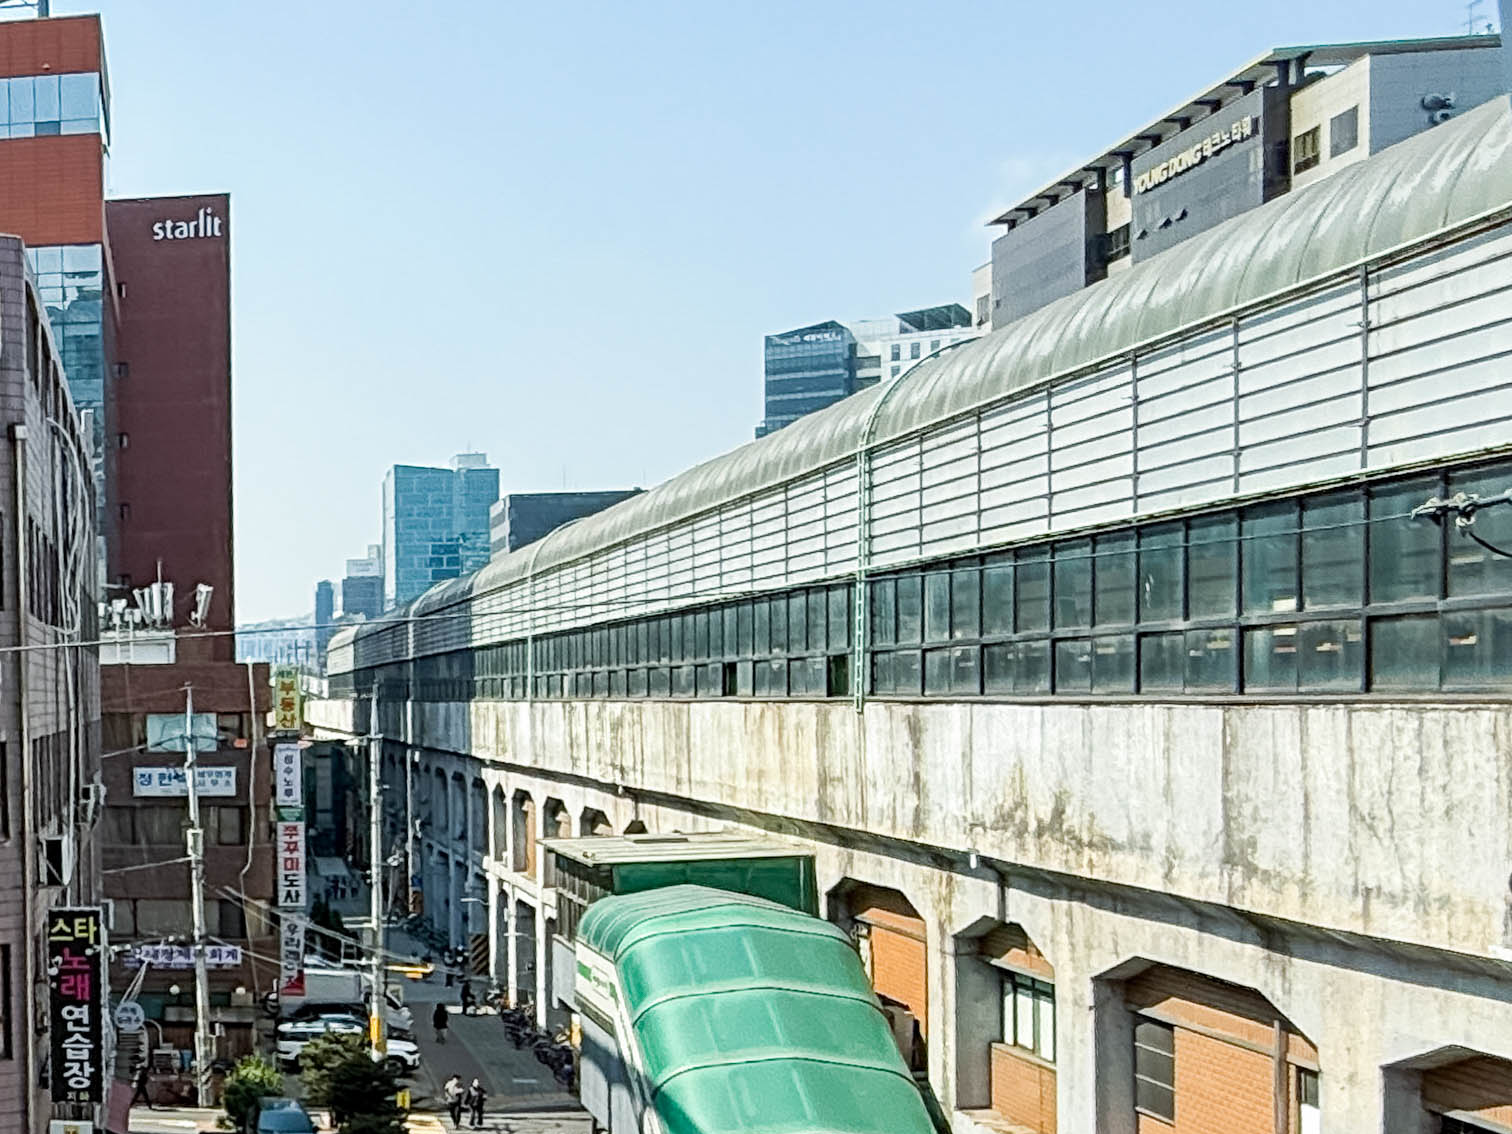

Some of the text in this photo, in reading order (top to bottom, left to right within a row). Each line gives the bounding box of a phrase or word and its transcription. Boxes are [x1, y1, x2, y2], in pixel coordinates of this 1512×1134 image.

[153, 207, 221, 240] starlit
[49, 916, 97, 944] 스타
[60, 947, 92, 1000] 노래
[61, 1004, 95, 1088] 연습장
